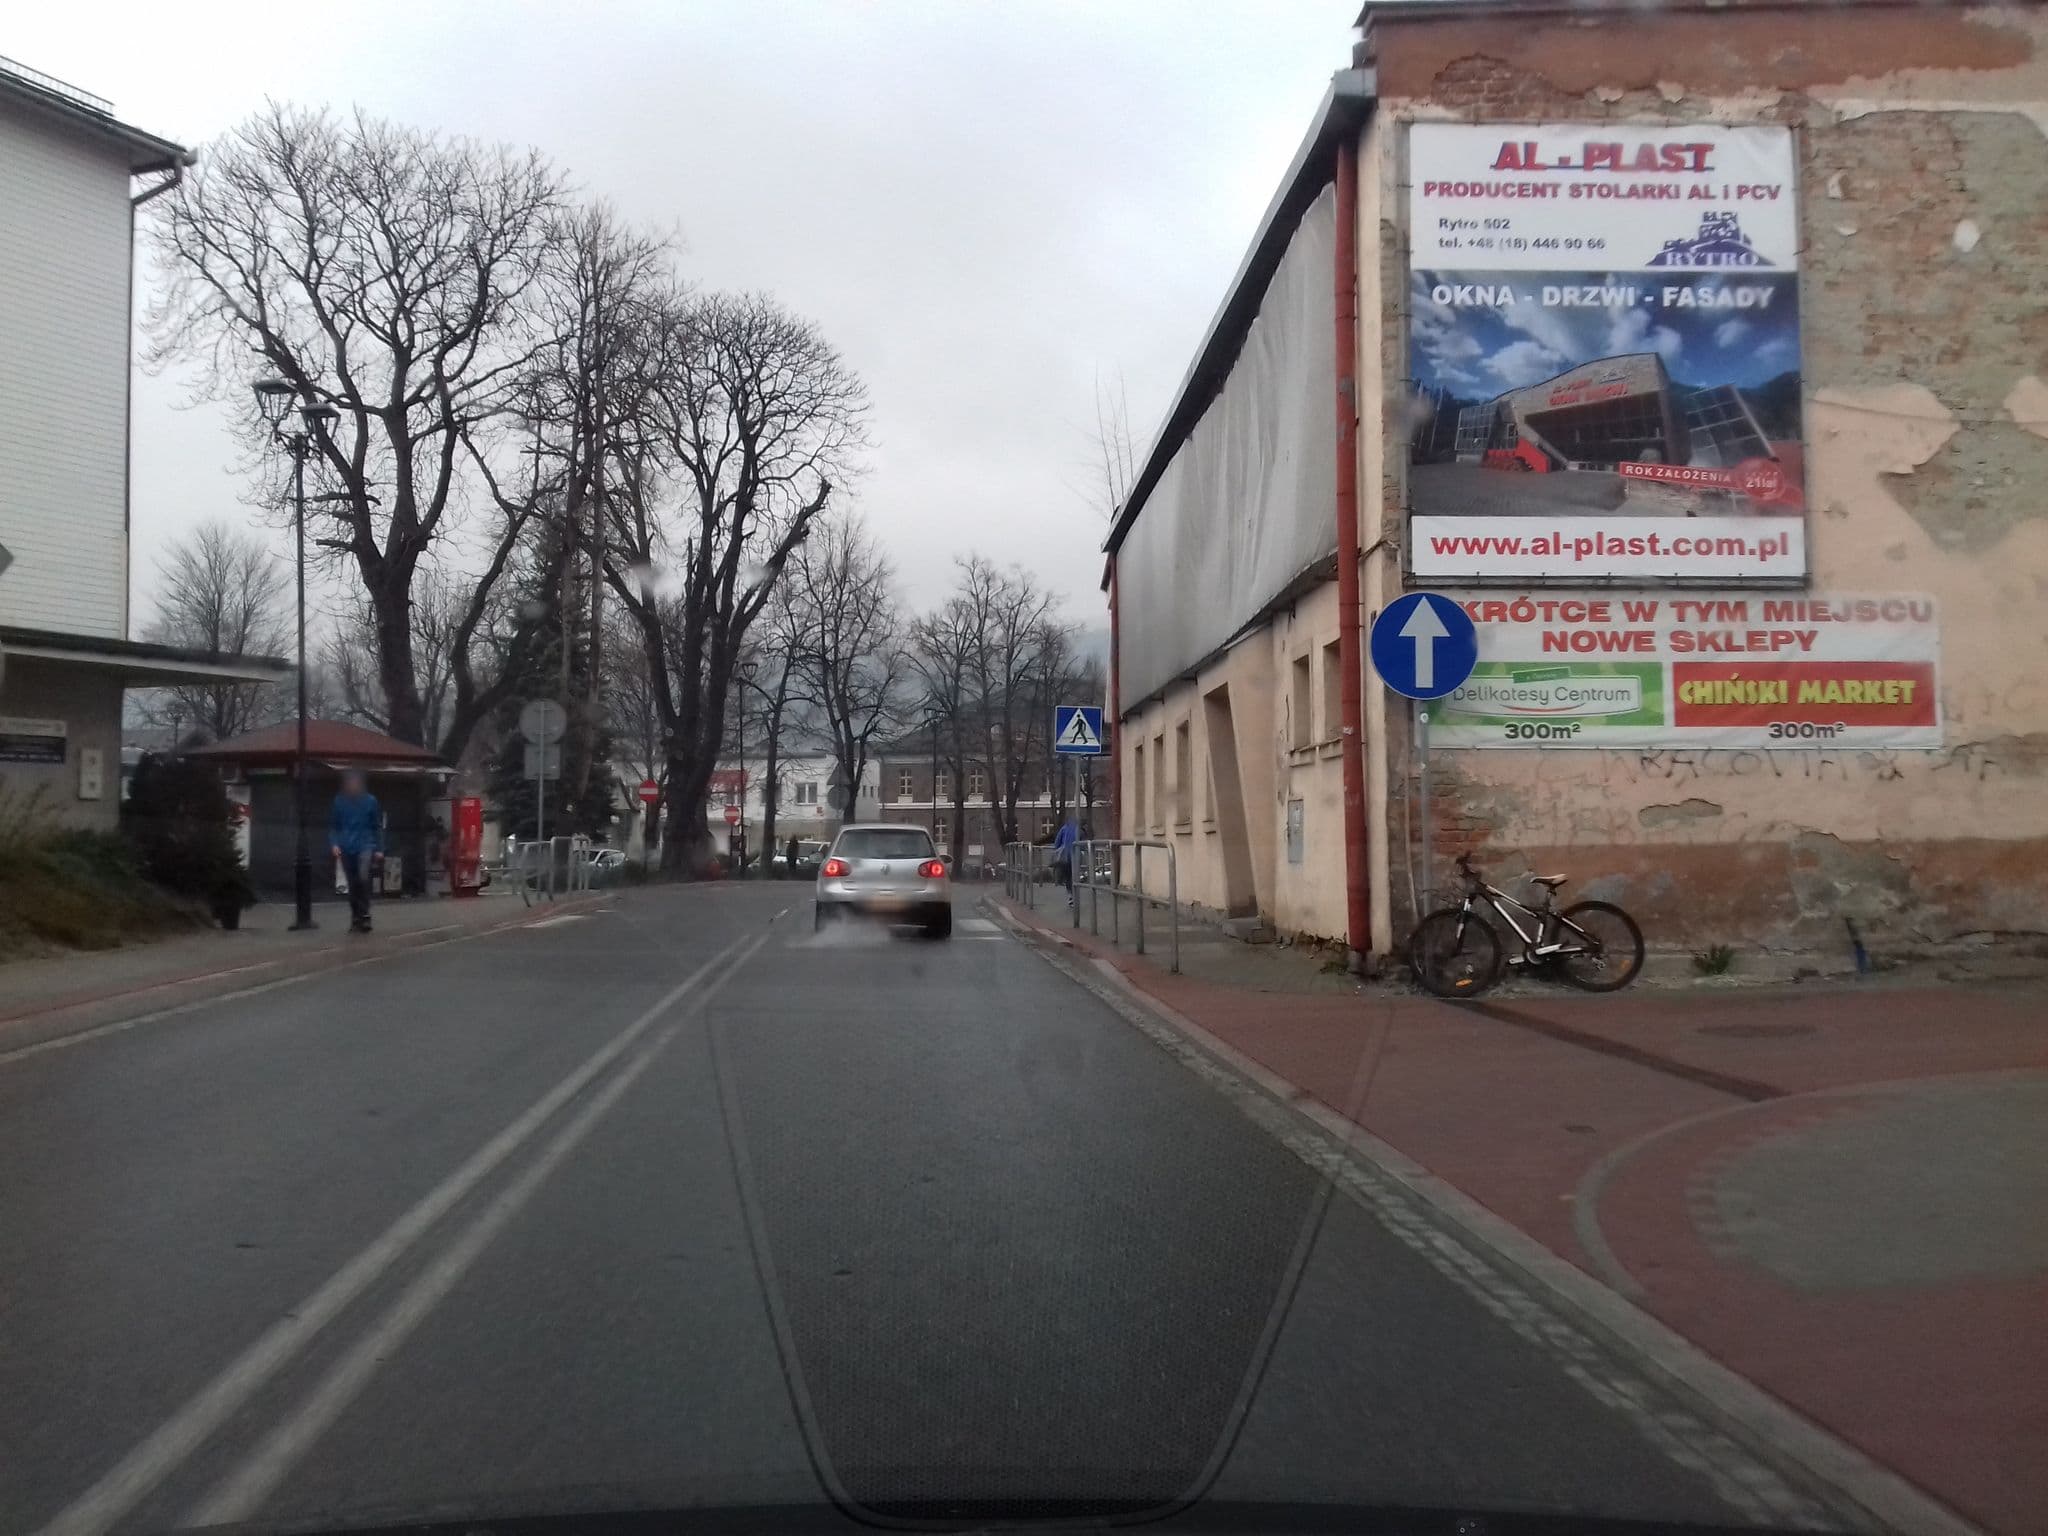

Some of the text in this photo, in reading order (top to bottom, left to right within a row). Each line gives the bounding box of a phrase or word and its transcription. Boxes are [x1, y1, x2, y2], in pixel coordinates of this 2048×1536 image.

[1494, 141, 1548, 171] AL
[1583, 142, 1715, 172] PLAST
[1424, 181, 1561, 198] PRODUCENT
[1569, 183, 1681, 199] STOLARKI
[1687, 184, 1717, 199] AL
[1737, 184, 1782, 200] PCV
[1439, 218, 1478, 231] Rytro
[1439, 238, 1463, 248] tel.
[1666, 252, 1759, 266] RYTRO
[1432, 285, 1516, 306] OKNA
[1542, 286, 1635, 306] DRZWI
[1662, 286, 1775, 308] FASADY
[1625, 465, 1653, 476] ROK
[1431, 532, 1789, 561] www.al-plast.com.pl
[1457, 596, 1933, 622] KRÓTCE W TYM MIEJSCU
[1542, 630, 1818, 652] NOWE SKLEPY
[1454, 686, 1631, 705] Delikatesy Centrum
[1679, 672, 1916, 704] CHIŃSKI MARKET
